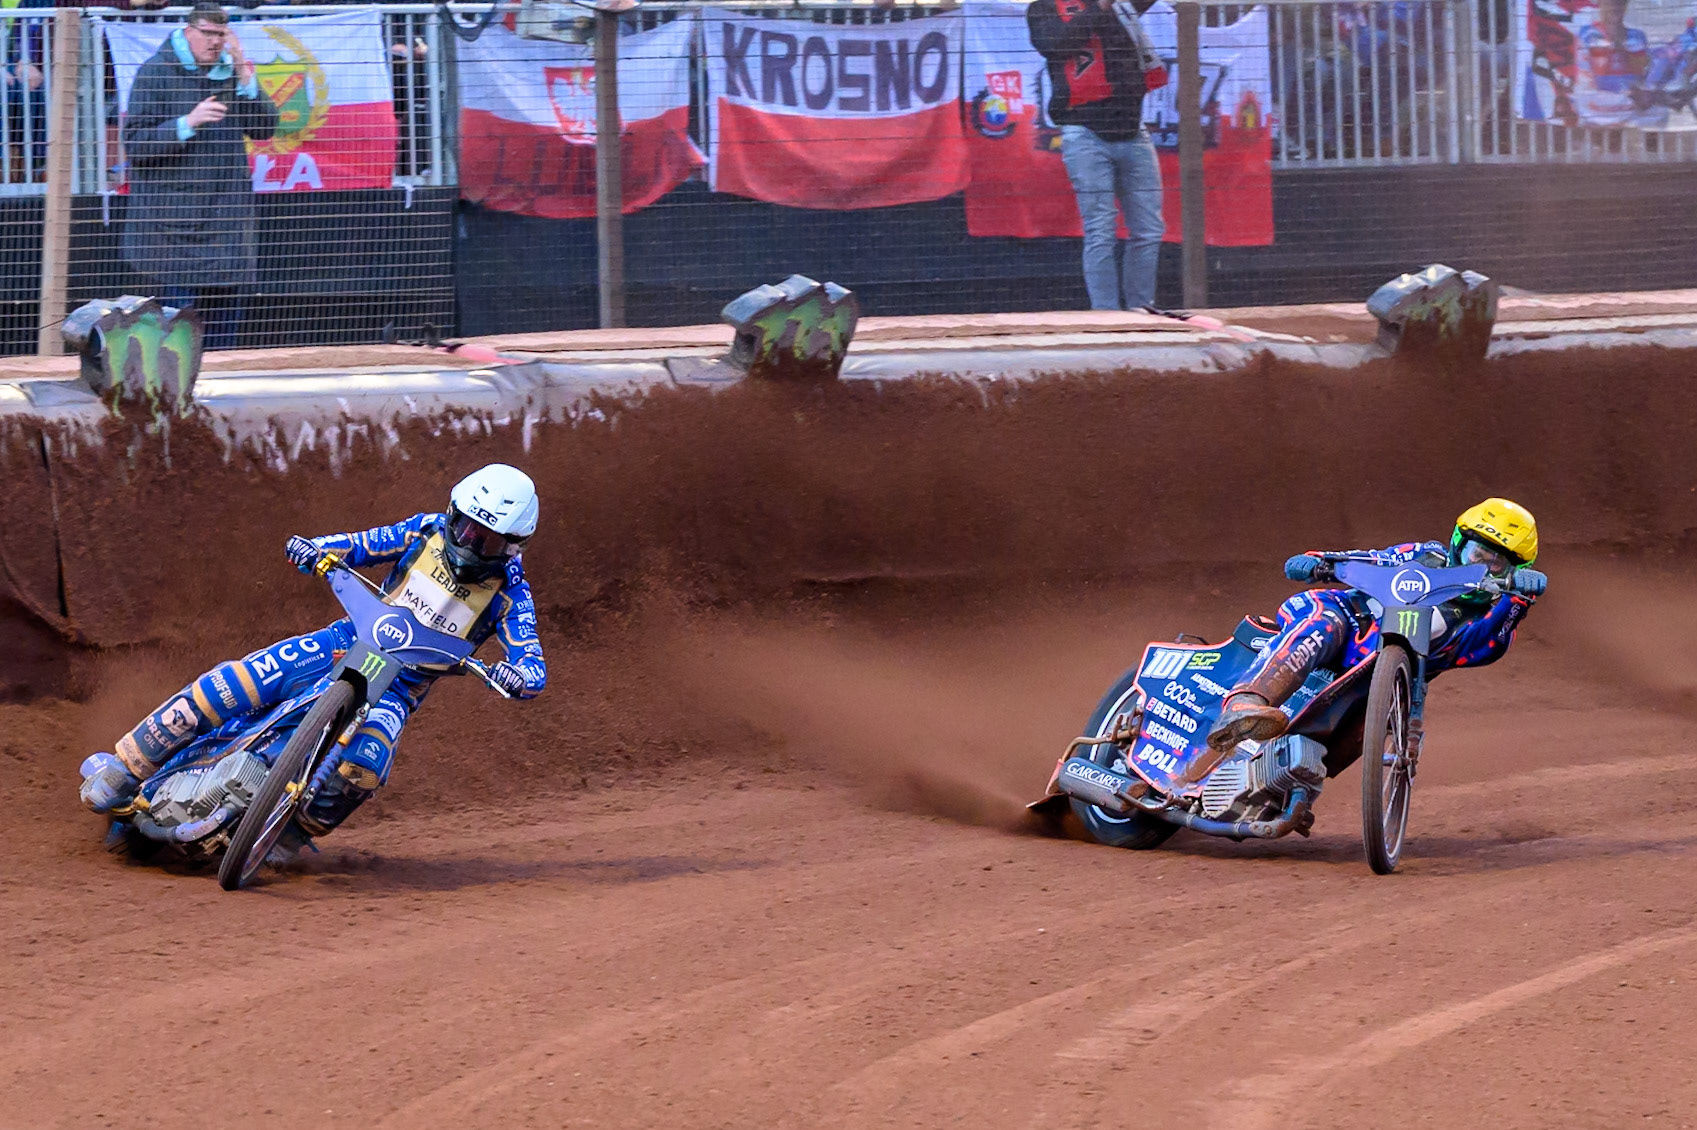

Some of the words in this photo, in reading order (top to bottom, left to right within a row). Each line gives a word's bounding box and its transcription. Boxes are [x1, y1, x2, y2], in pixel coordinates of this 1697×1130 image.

[723, 22, 948, 110] KROSNO
[1475, 523, 1510, 546] BOLL
[430, 566, 472, 602] LEADER
[1397, 580, 1423, 592] ATPI
[403, 588, 459, 635] MAYFIELD
[378, 622, 407, 644] ATPI
[249, 637, 321, 685] MCG
[293, 654, 321, 669] Logistics
[1141, 648, 1196, 680] 101
[146, 715, 176, 749] ORLEN
[1153, 701, 1198, 734] BETARD
[143, 733, 156, 749] OIL
[1145, 720, 1190, 753] BECKHOFF
[1137, 743, 1178, 774] BOLL
